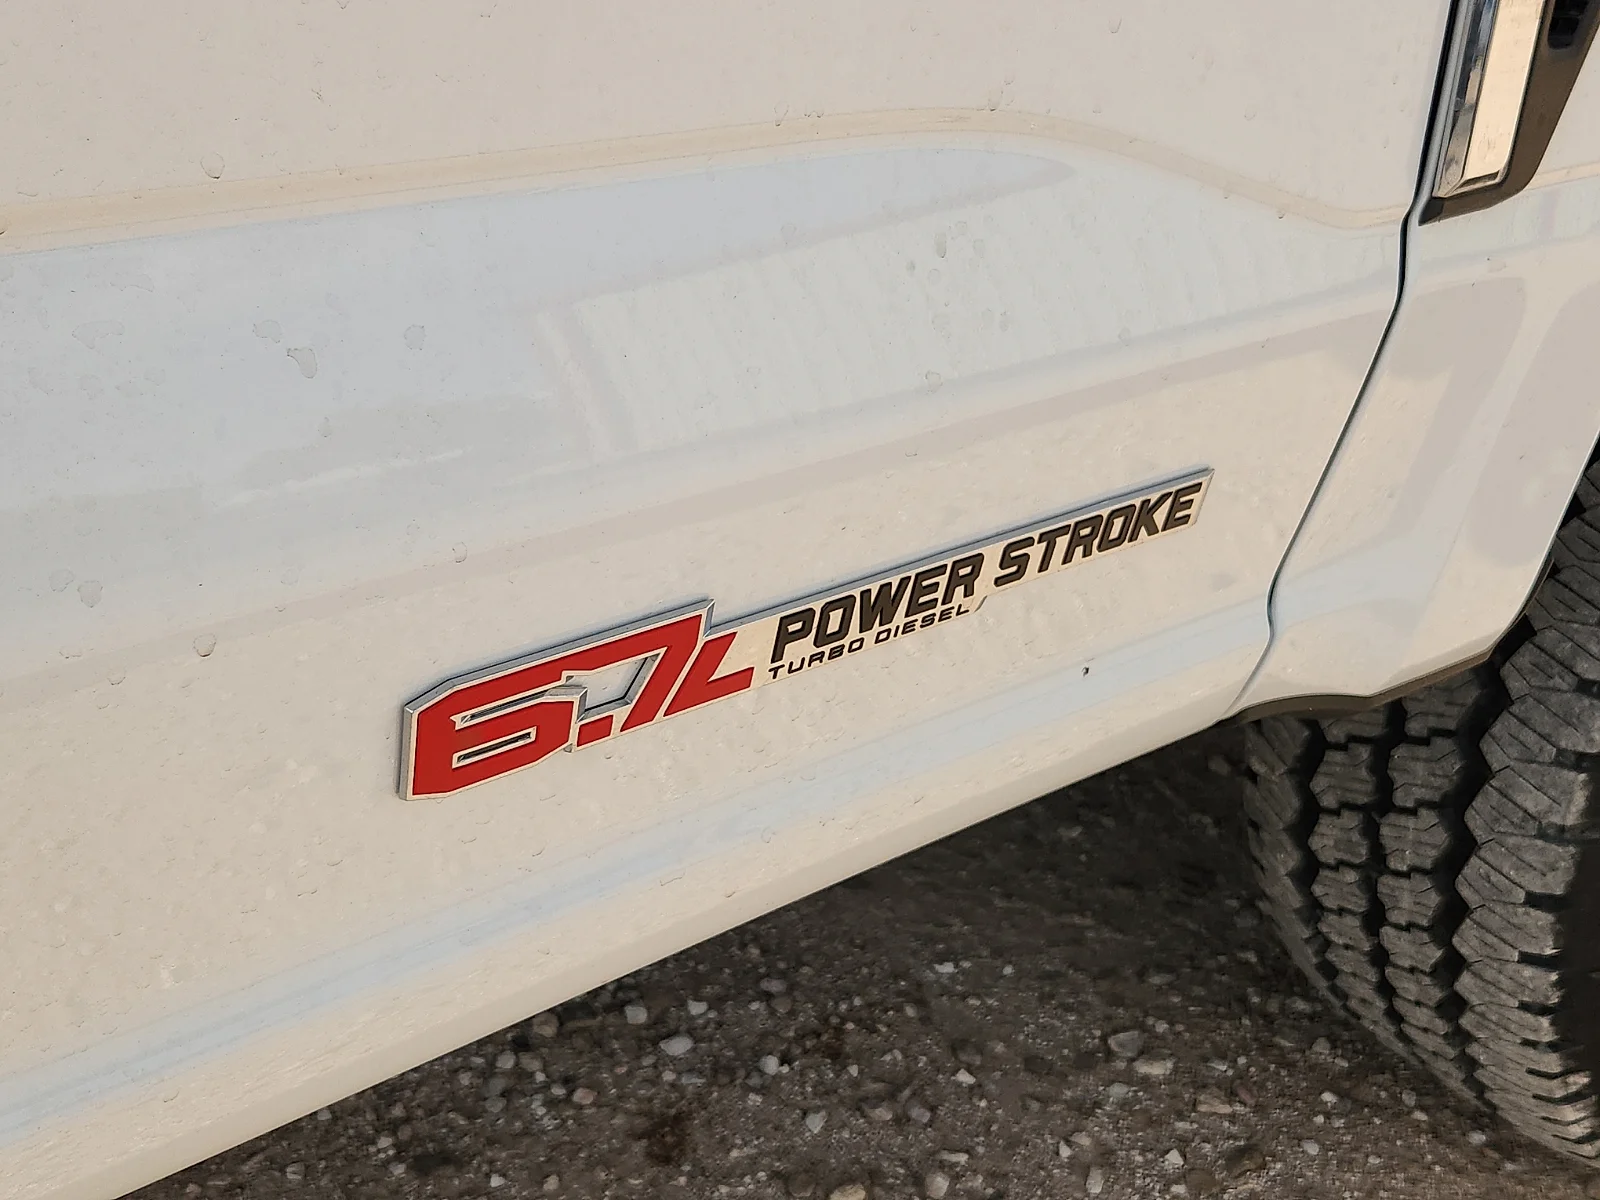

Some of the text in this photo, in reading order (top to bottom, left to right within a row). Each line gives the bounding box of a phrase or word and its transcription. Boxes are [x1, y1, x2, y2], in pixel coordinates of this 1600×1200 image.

[411, 481, 1203, 796] 6.7L POWER STROKE
[768, 603, 970, 680] TURBO DIESEL
